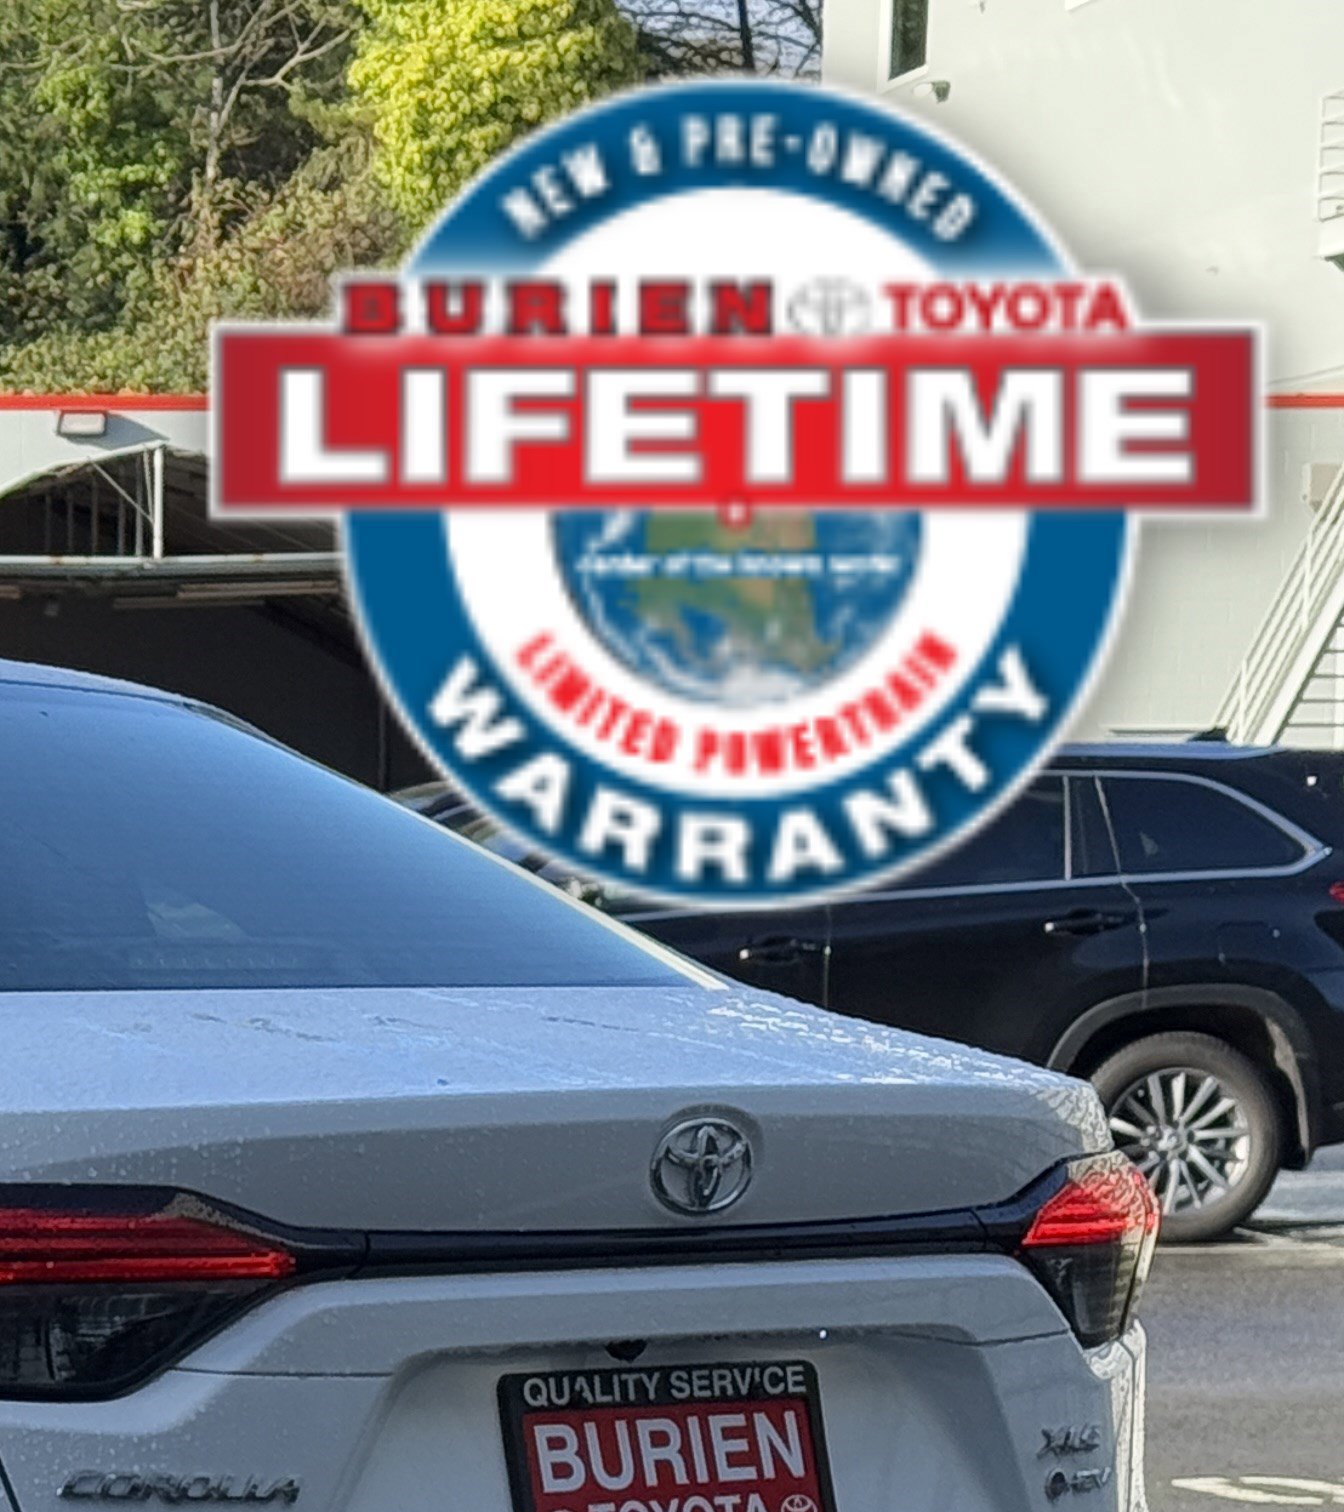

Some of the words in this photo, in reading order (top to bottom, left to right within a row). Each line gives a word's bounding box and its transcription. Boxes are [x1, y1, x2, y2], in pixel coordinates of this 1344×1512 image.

[523, 1371, 660, 1408] QUALITY
[533, 1410, 807, 1495] BURIEN
[60, 1470, 301, 1508] COROLLA
